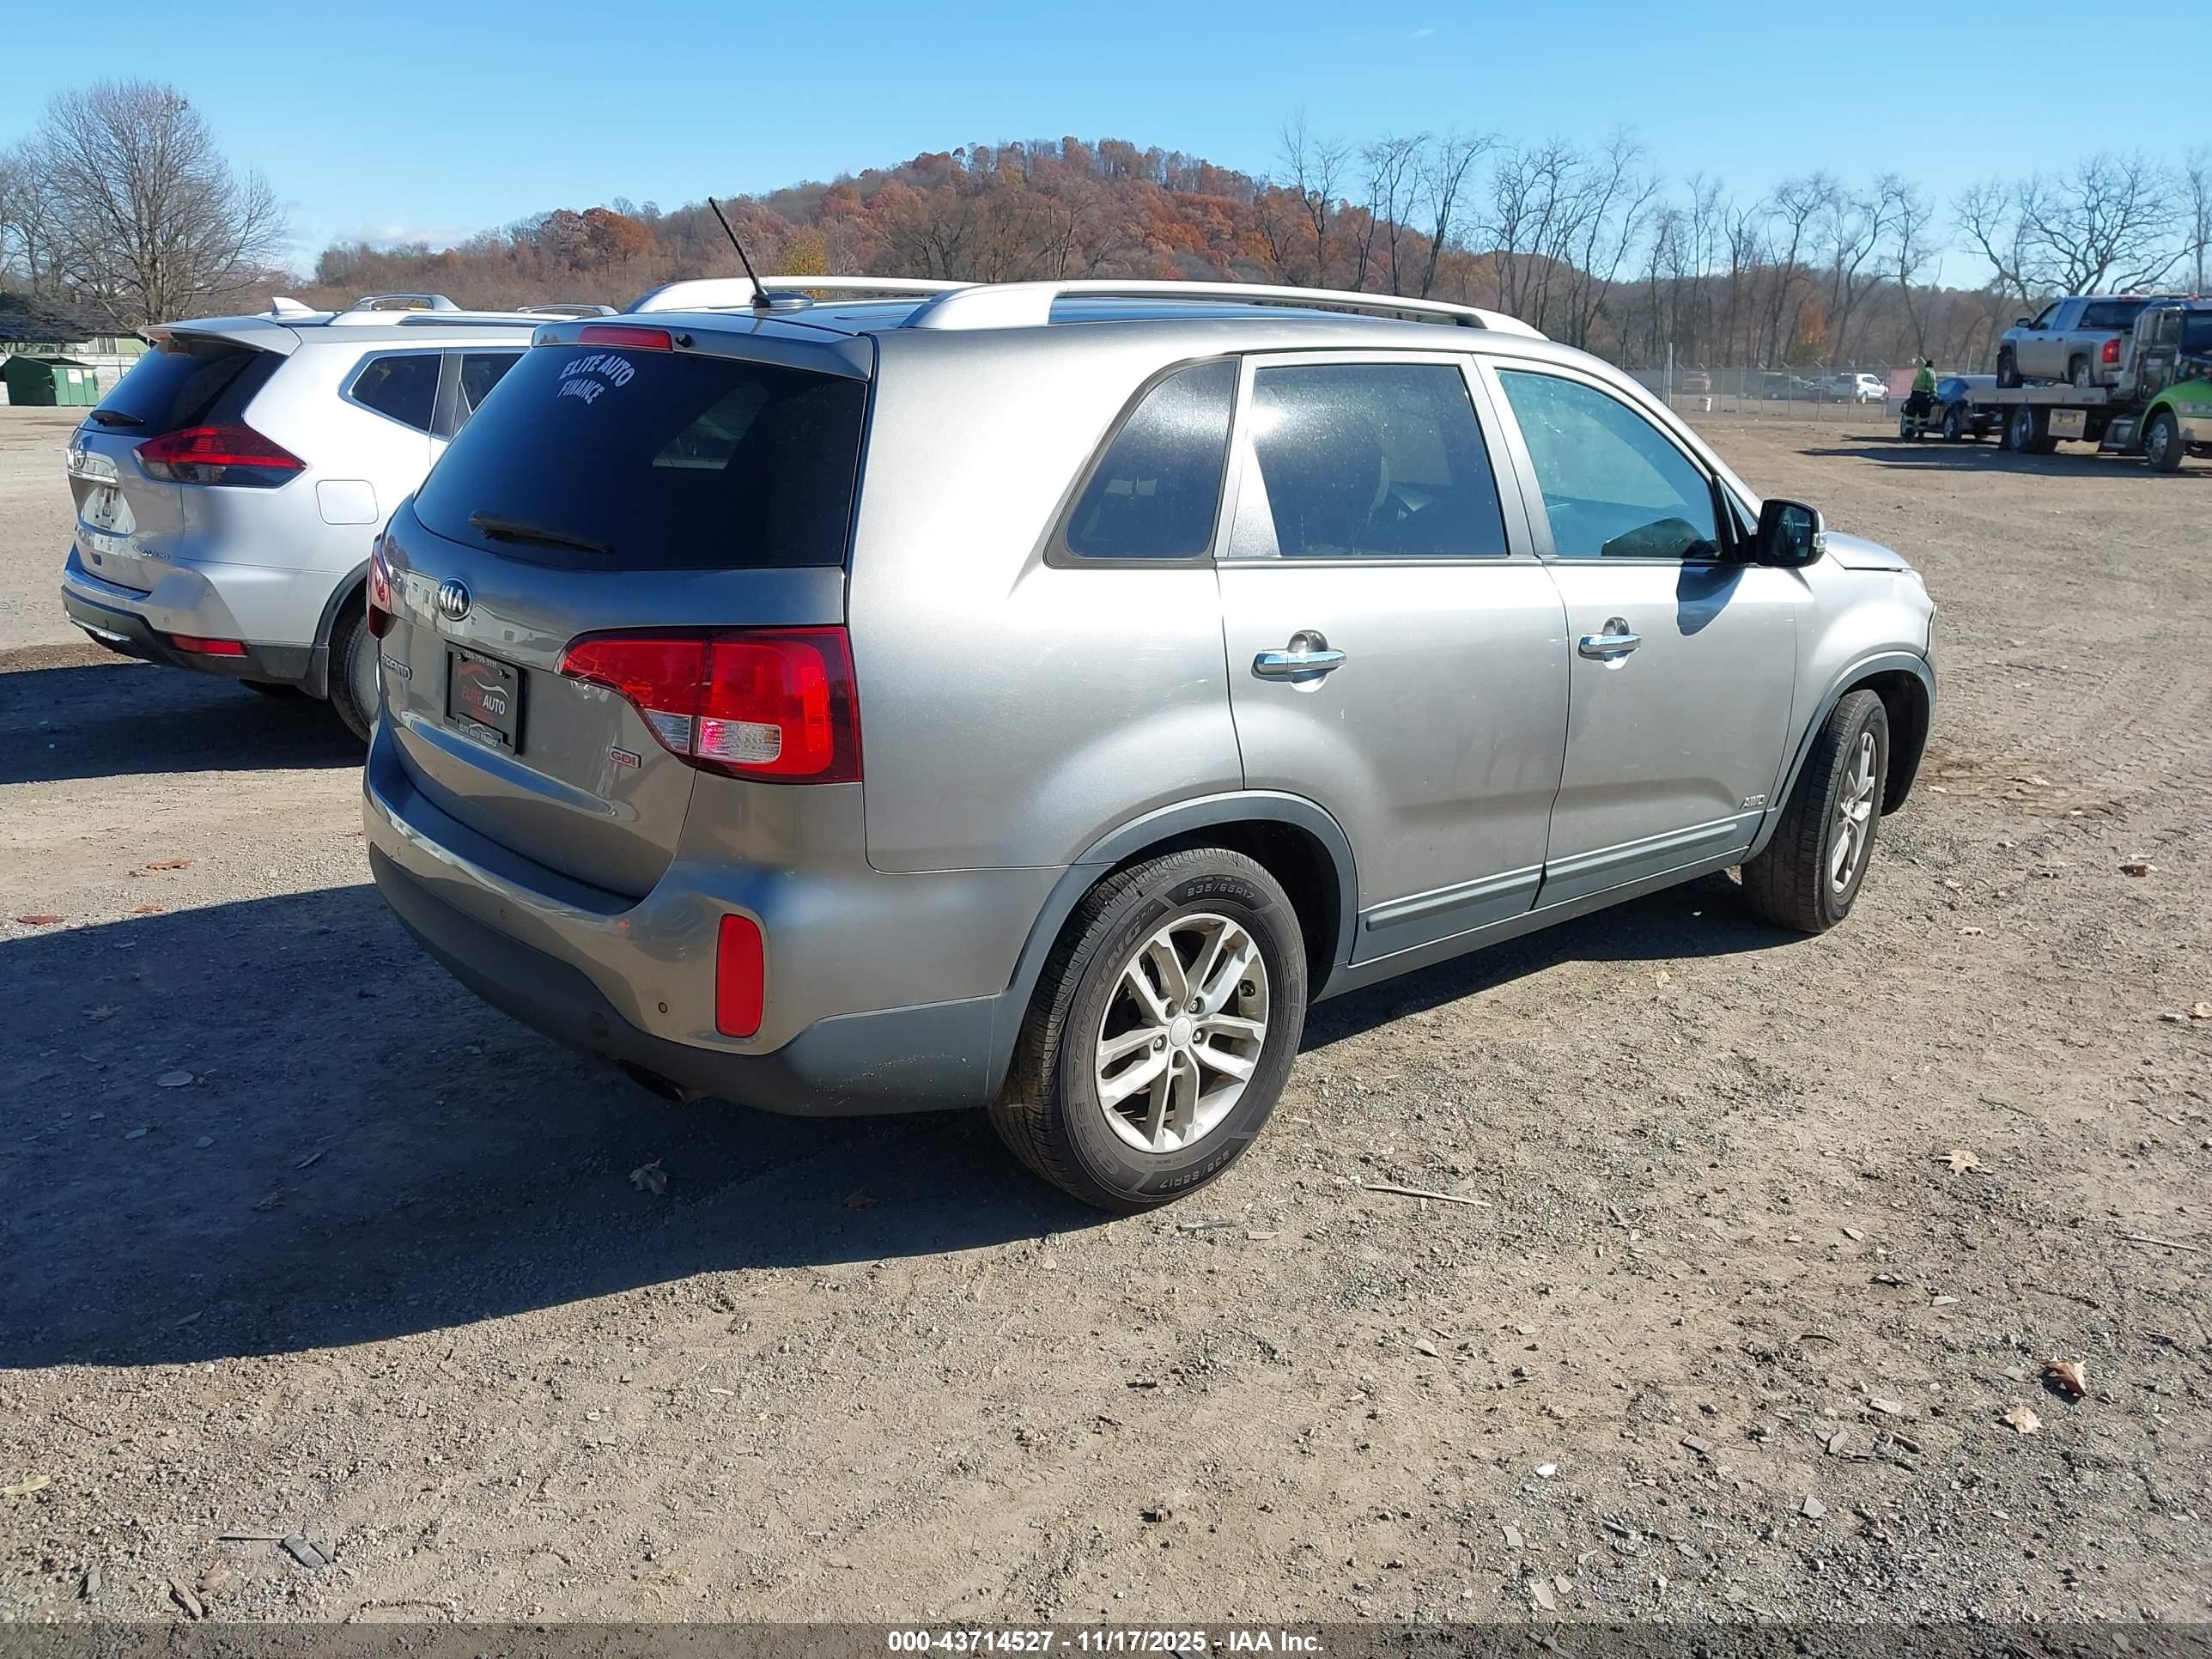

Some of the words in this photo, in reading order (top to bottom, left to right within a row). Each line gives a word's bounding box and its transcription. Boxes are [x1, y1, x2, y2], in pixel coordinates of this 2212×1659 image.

[559, 355, 605, 380] ELITE
[598, 355, 635, 387] AUTO
[557, 379, 605, 405] FINANCE
[440, 585, 464, 614] KIA
[483, 694, 506, 715] AUTO
[611, 750, 636, 766] GDI
[1741, 794, 1765, 810] AWD
[1187, 883, 1255, 899] 235/65R17
